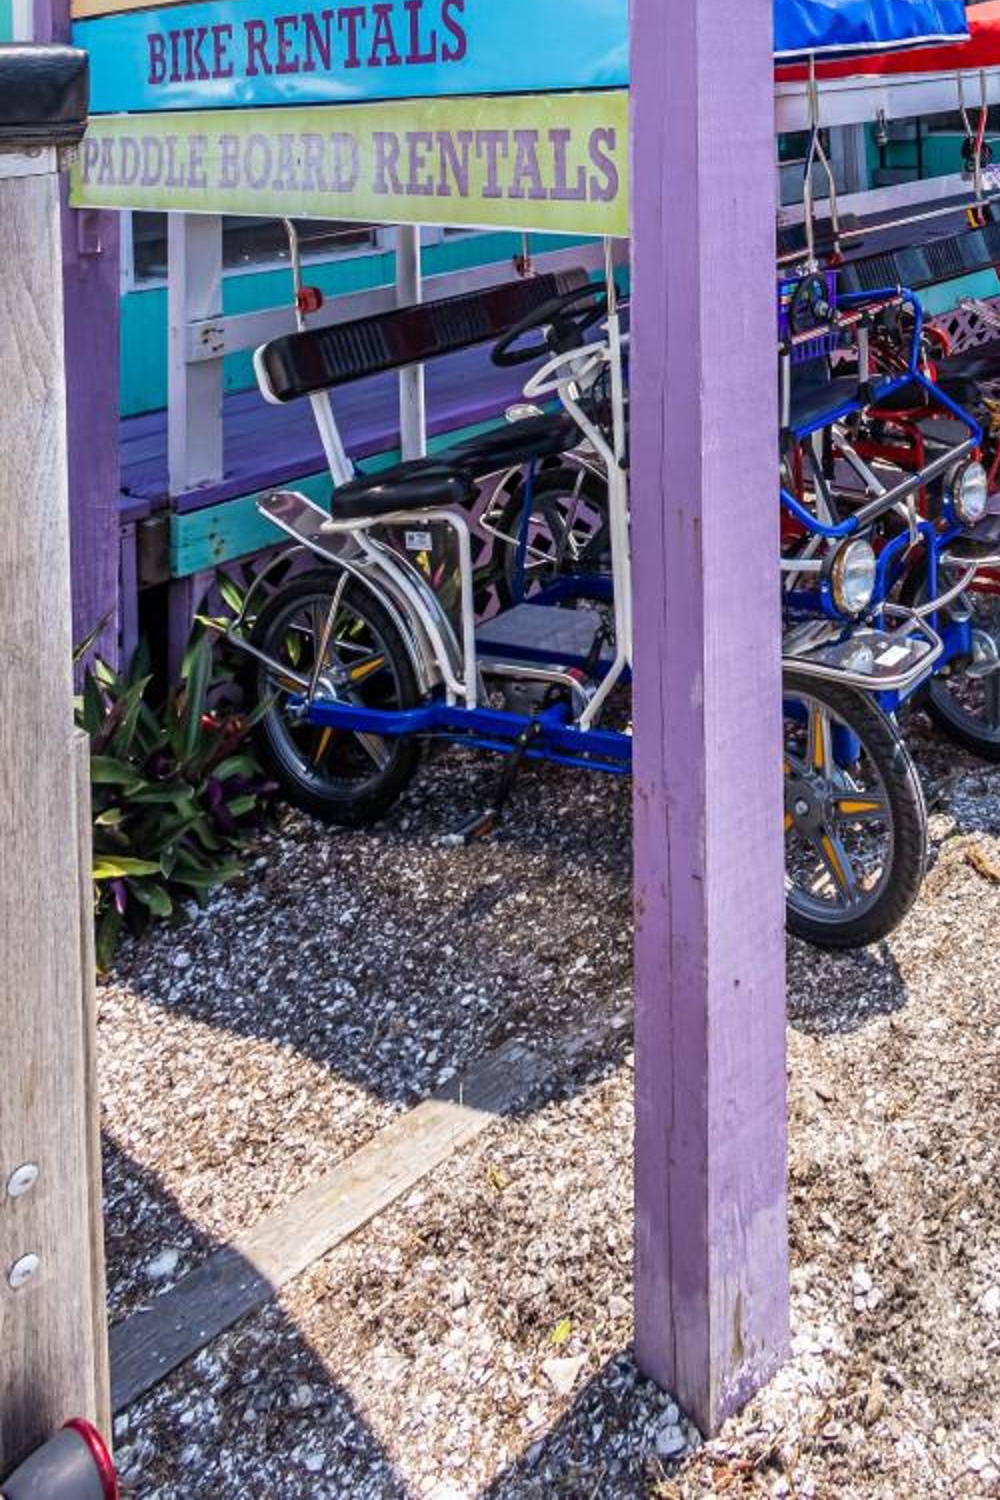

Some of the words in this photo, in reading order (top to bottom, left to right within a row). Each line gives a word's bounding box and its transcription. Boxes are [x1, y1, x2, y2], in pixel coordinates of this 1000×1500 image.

[147, 22, 234, 85] BIKE
[82, 132, 208, 189] PADDLE
[218, 130, 359, 194] BOARD
[372, 127, 620, 203] RENTALS
